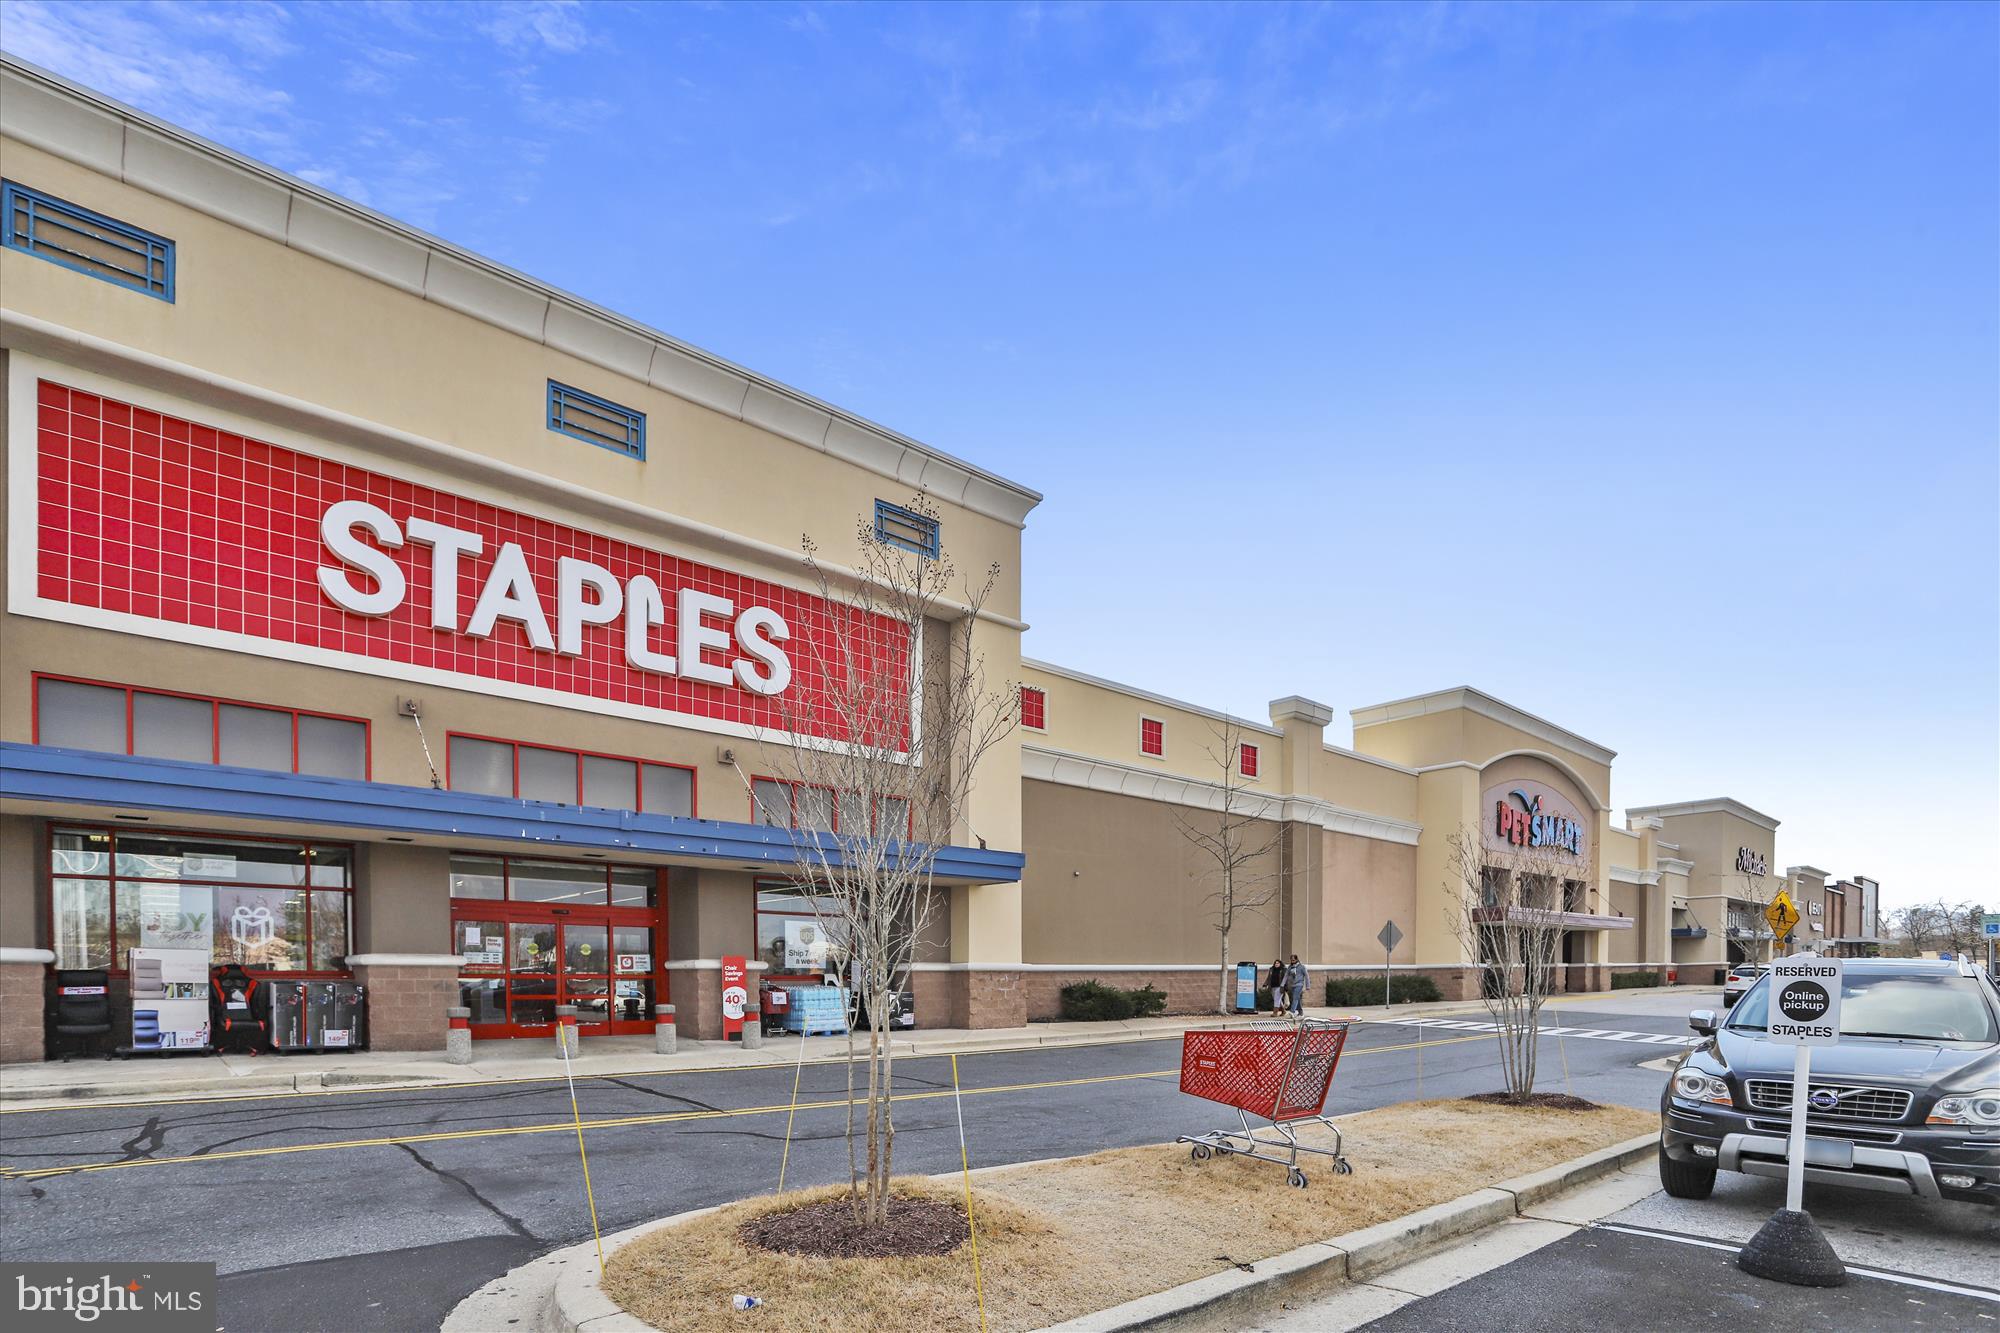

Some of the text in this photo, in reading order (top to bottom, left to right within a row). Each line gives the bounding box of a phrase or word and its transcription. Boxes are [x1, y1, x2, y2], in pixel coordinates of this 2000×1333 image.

[315, 500, 792, 695] STAPLES
[1497, 800, 1584, 855] PETSMART
[788, 949, 804, 958] Ship
[1775, 966, 1836, 977] RESERVED
[1785, 991, 1824, 1001] Online
[1783, 1000, 1824, 1012] pickup
[1772, 1024, 1833, 1038] STAPLES
